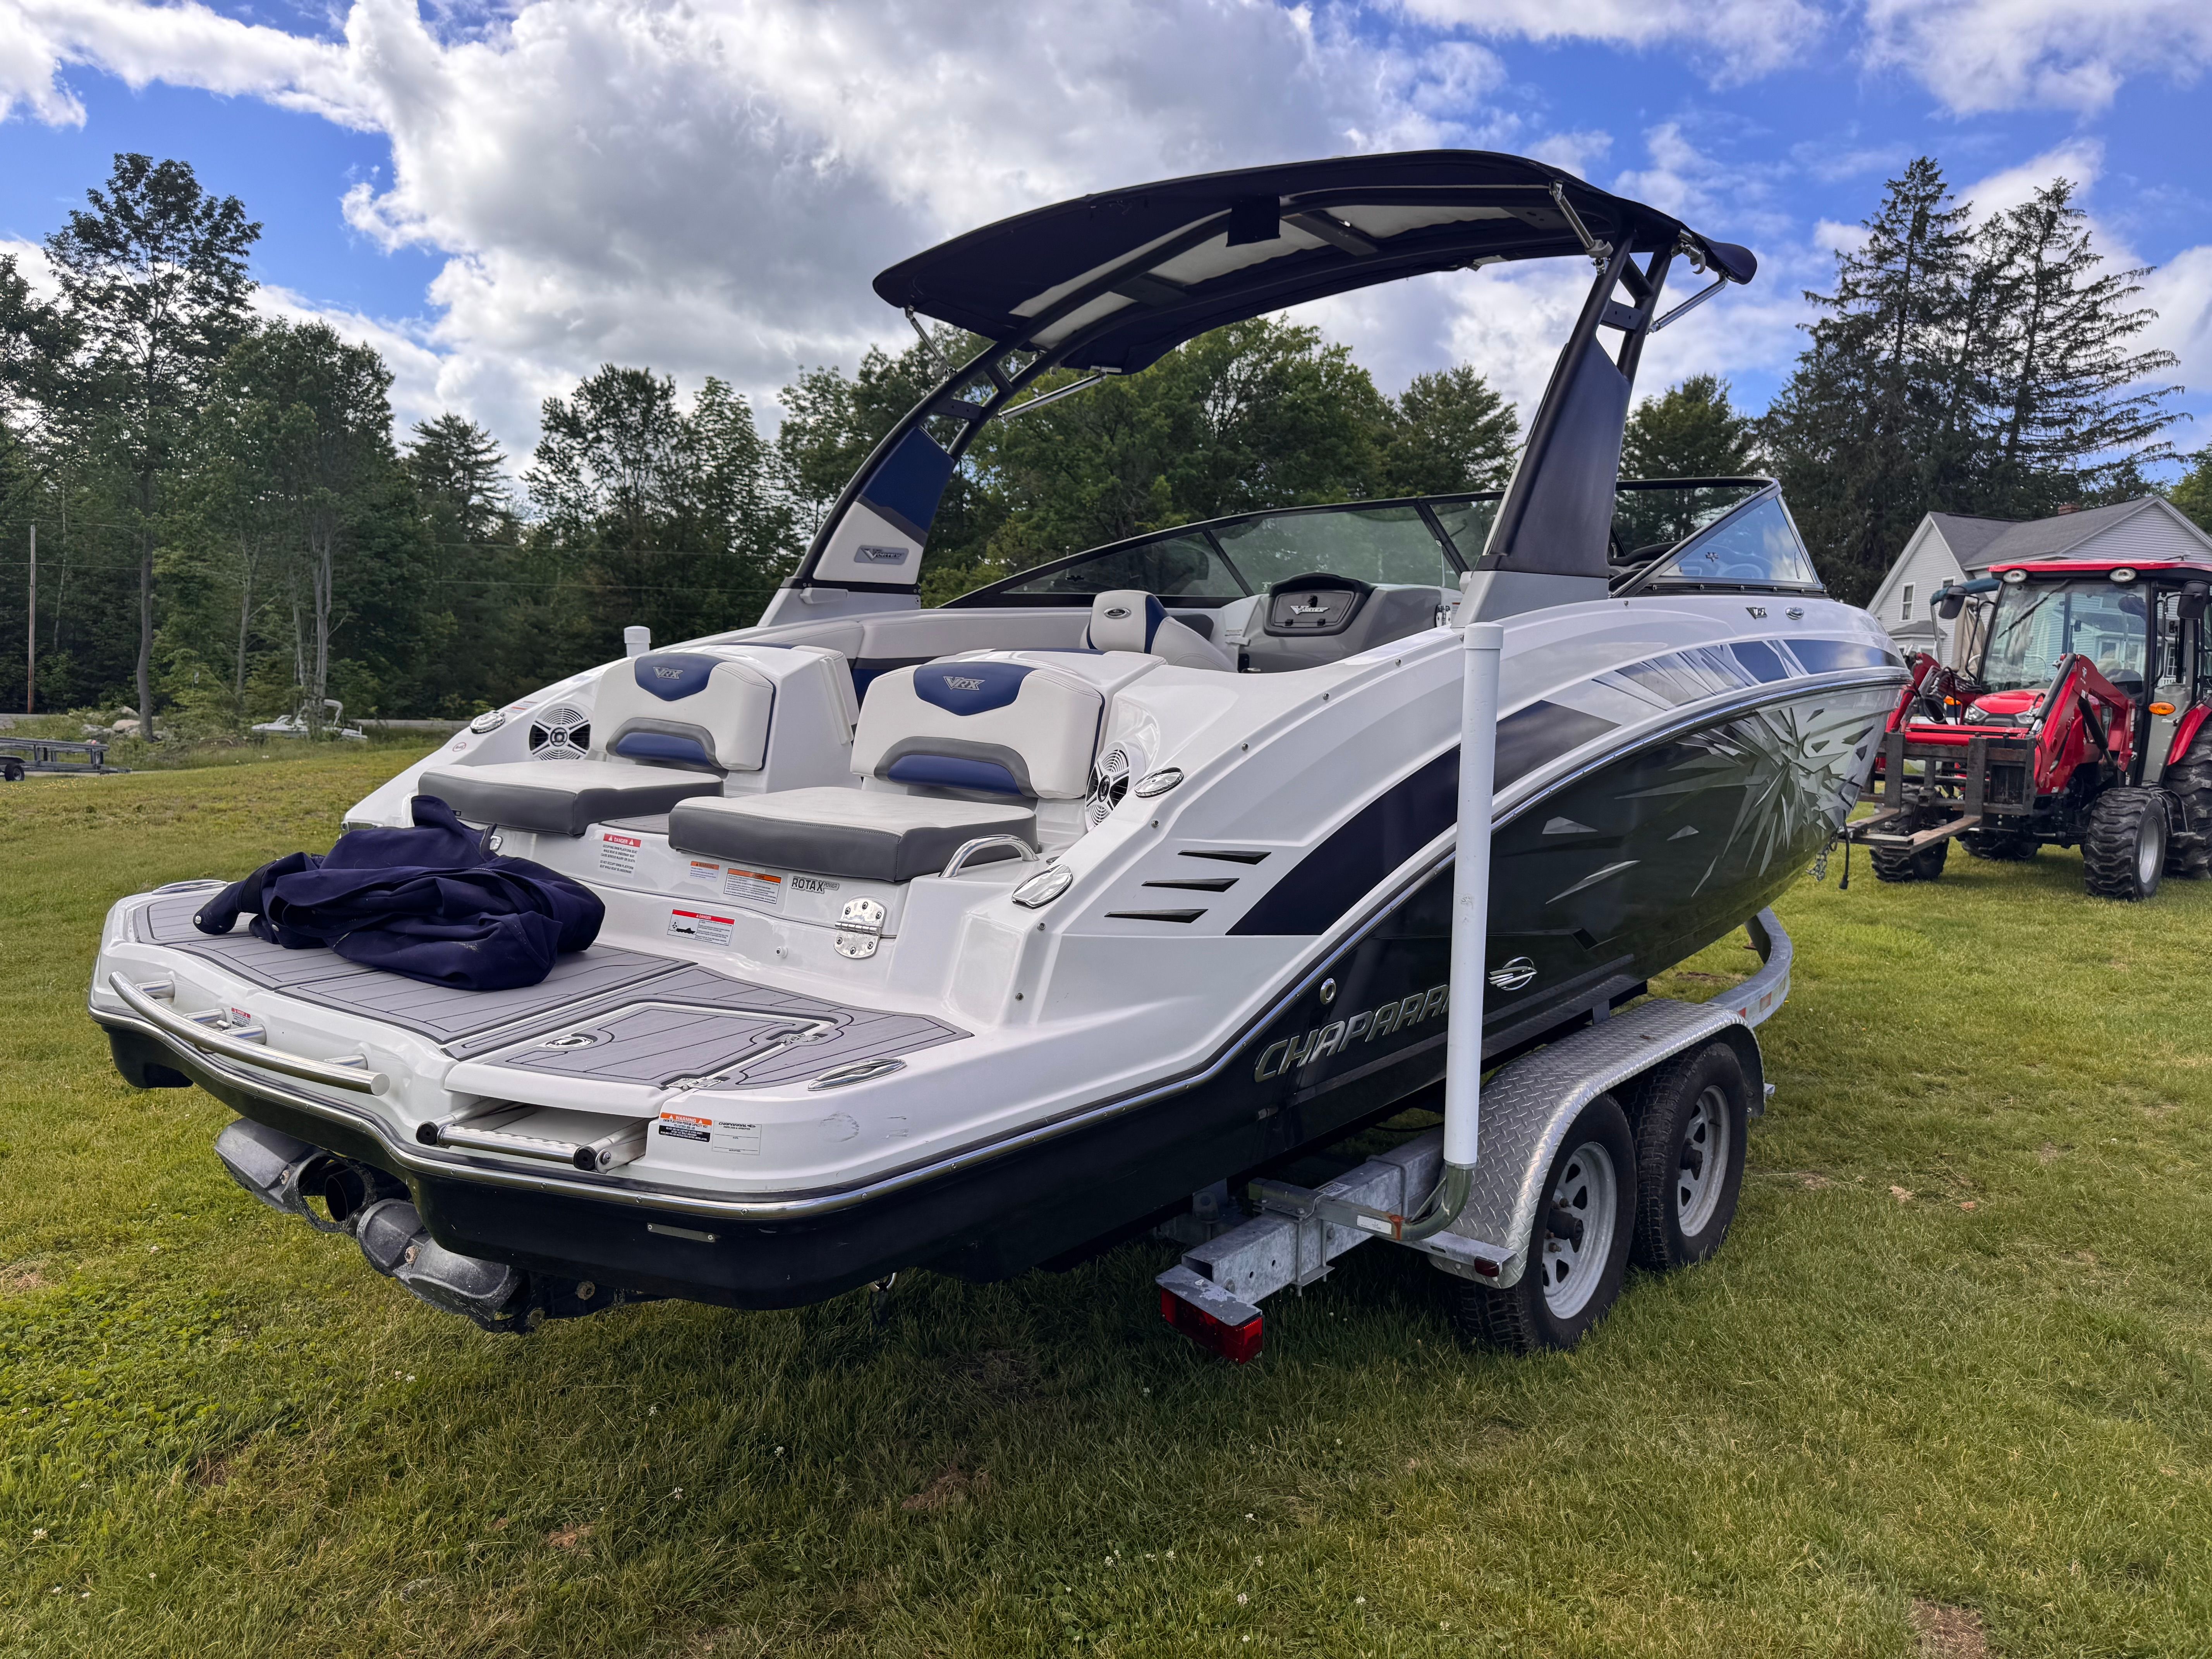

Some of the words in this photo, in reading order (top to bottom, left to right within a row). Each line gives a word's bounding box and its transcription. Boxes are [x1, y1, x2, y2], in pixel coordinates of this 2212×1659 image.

[654, 667, 683, 678] VRX
[944, 677, 984, 689] VRX
[792, 878, 824, 892] ROTAX
[1254, 984, 1449, 1082] CHAPARR
